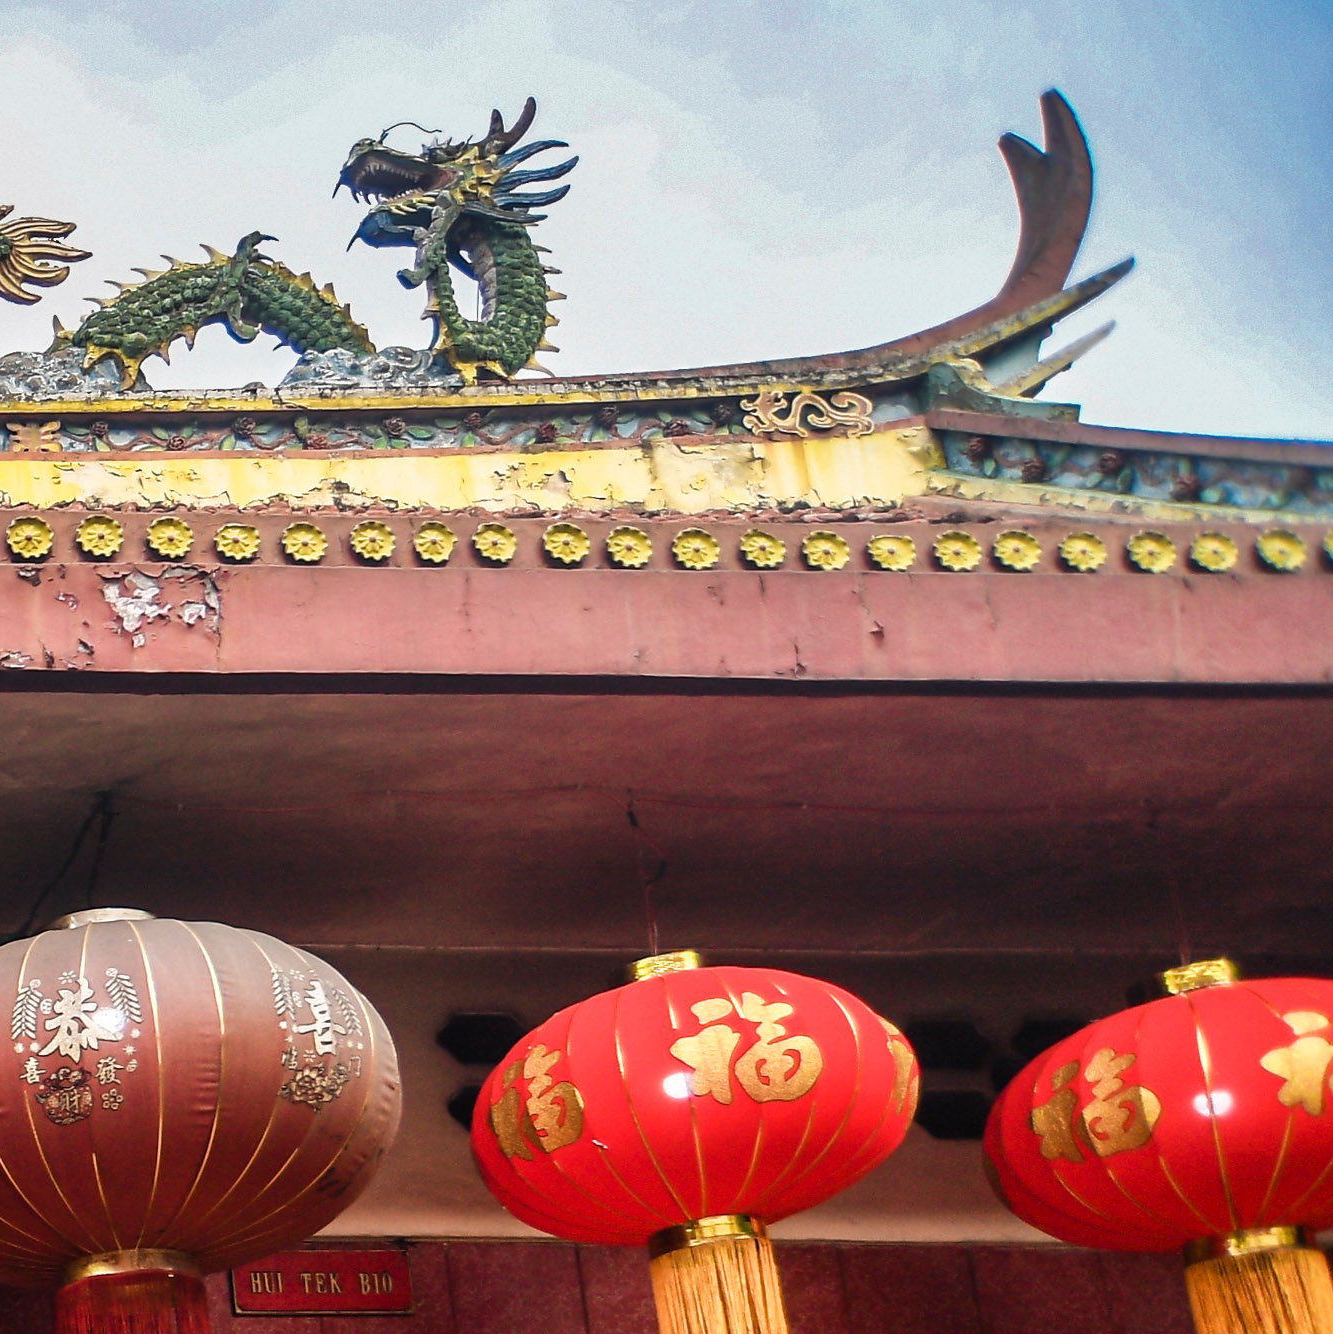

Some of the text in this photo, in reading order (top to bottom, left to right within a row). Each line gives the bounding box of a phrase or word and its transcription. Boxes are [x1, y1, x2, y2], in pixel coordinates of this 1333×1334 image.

[37, 977, 125, 1064] 恭
[670, 992, 824, 1106] 福
[490, 1043, 585, 1161] 福
[1030, 1047, 1163, 1163] 福
[250, 1271, 394, 1296] HUI TEK BIO
